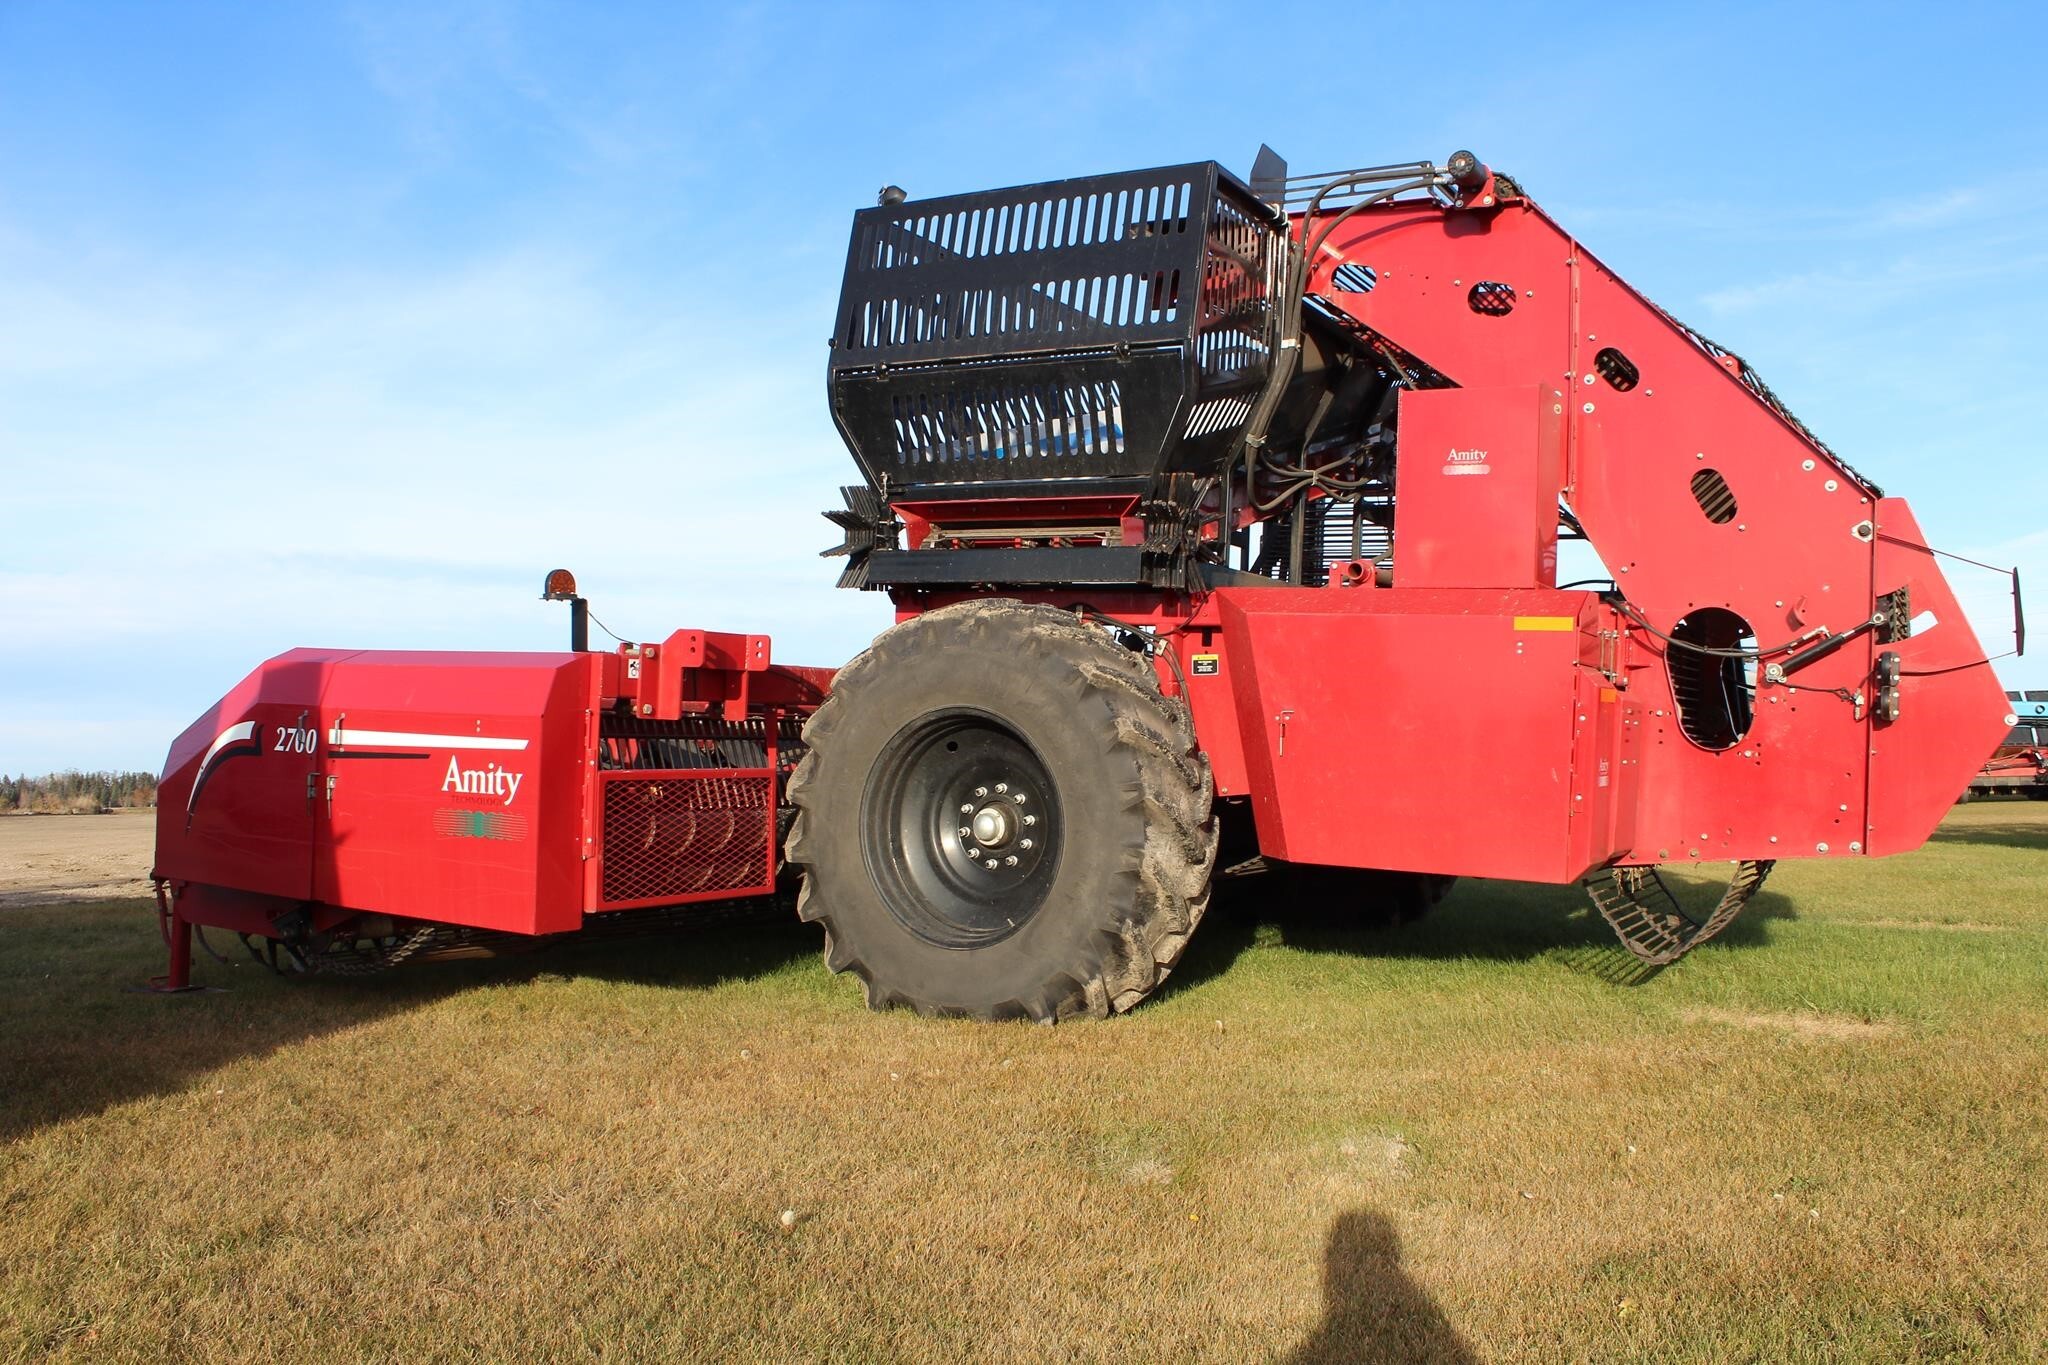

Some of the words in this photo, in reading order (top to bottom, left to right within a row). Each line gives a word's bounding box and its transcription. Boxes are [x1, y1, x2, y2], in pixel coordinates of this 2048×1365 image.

[1447, 448, 1488, 464] Amity
[273, 726, 317, 754] 2700
[441, 754, 523, 806] Amity
